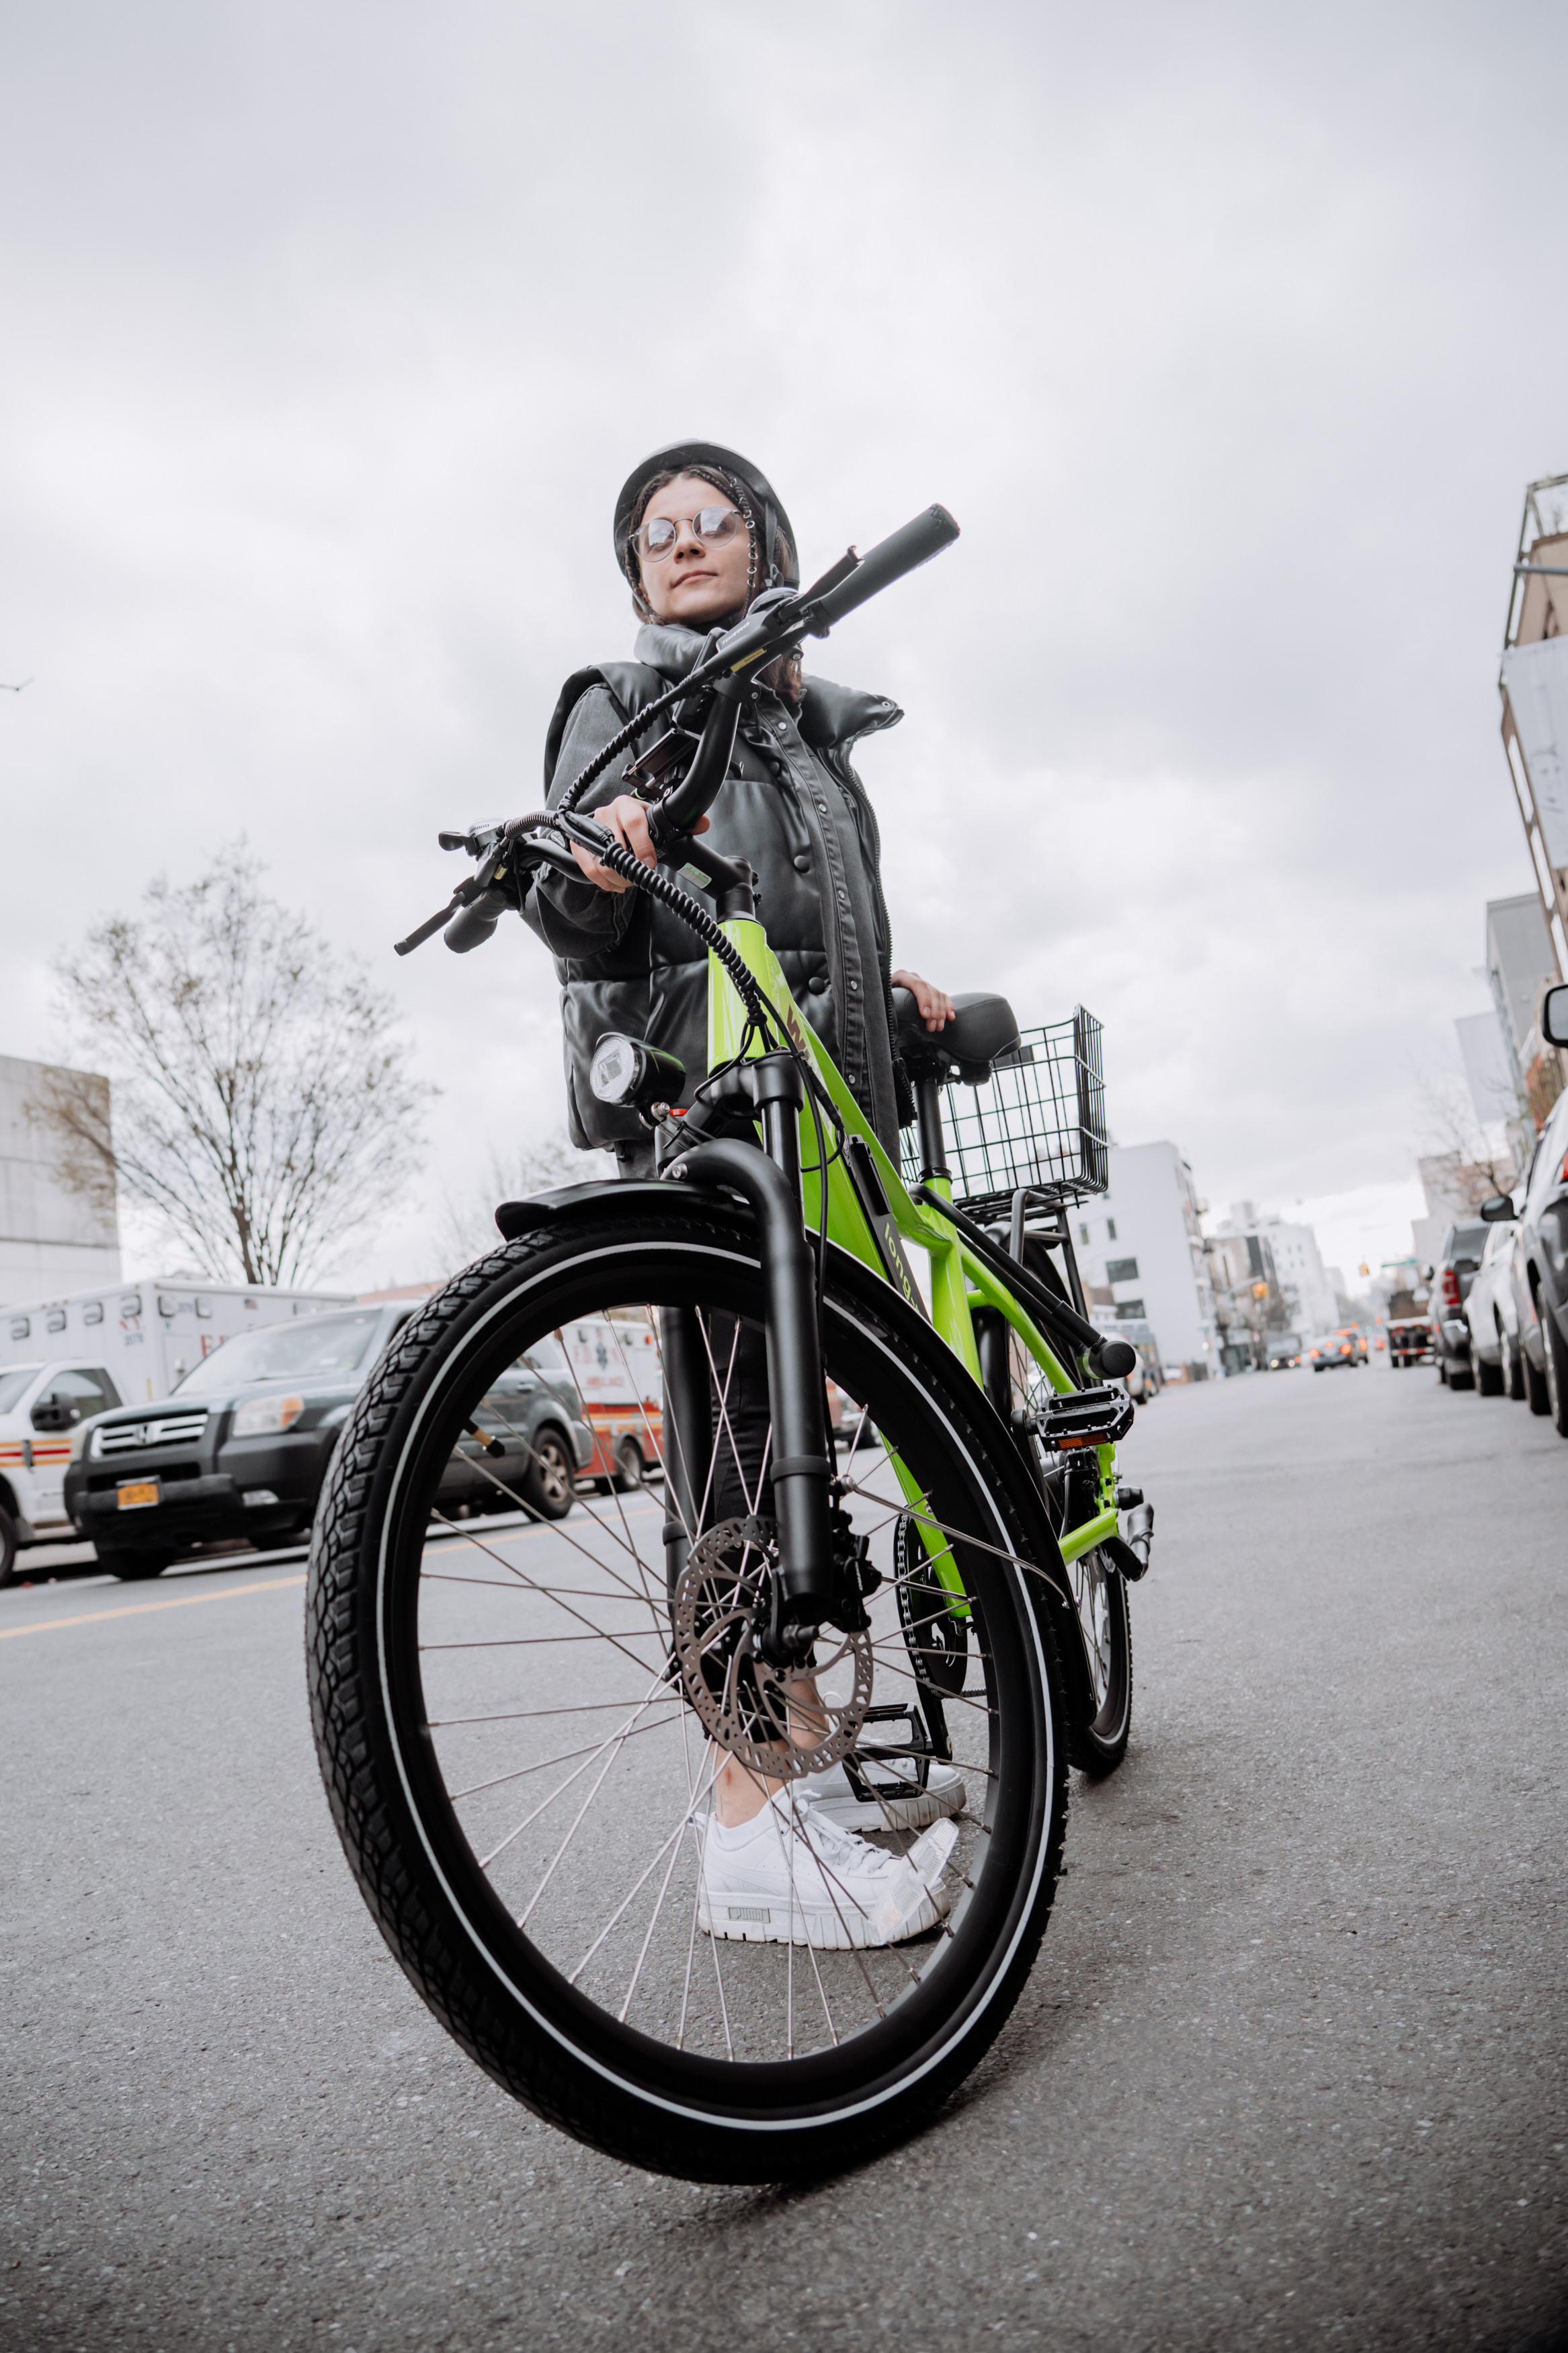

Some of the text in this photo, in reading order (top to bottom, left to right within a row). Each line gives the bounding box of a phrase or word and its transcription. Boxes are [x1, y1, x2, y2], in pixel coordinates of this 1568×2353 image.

[722, 621, 750, 645] TEKTRO
[884, 1222, 920, 1313] long-
[735, 1909, 764, 1921] PUMA
